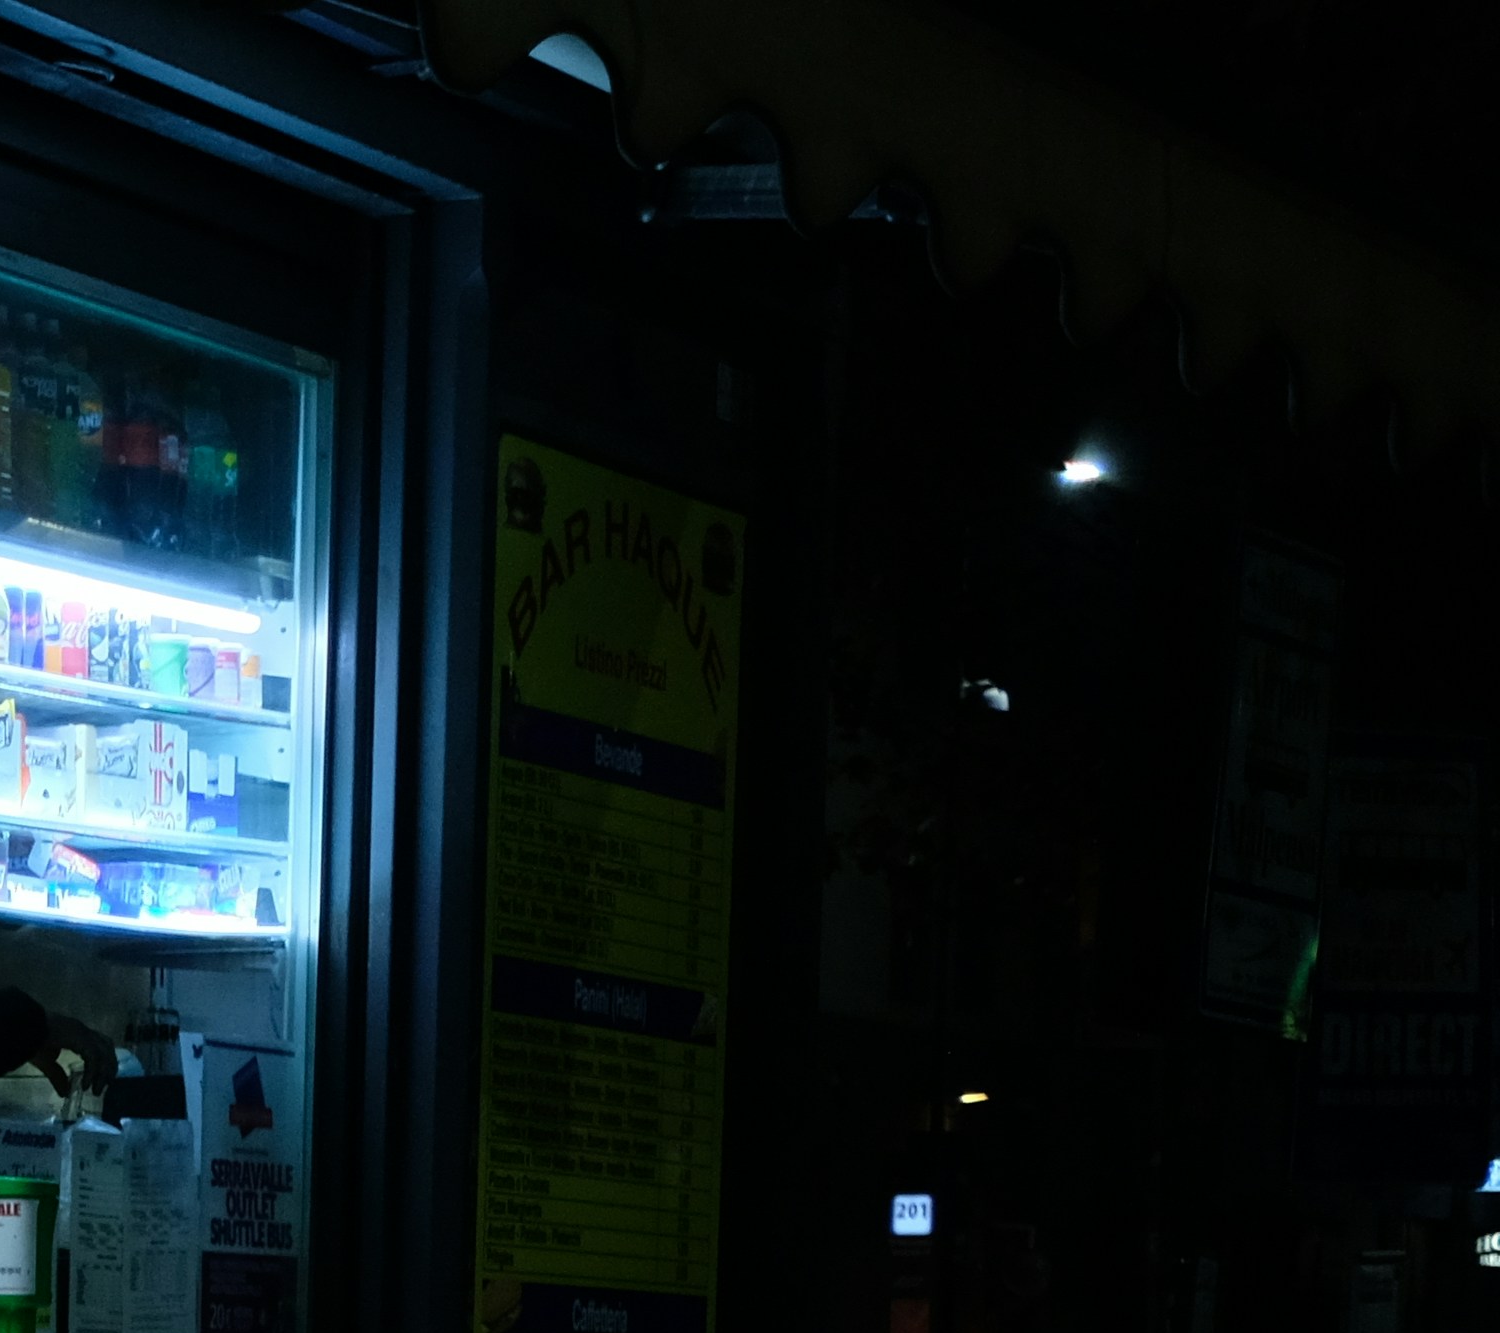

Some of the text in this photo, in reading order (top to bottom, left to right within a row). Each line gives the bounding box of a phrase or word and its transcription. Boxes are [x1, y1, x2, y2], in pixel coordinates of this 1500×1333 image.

[507, 500, 726, 714] BAR HAQUE
[211, 1158, 294, 1193] SERRAVALLE
[225, 1189, 277, 1220] OUTLET
[896, 1202, 928, 1219] 201
[210, 1217, 293, 1250] SHUTTLE BUS
